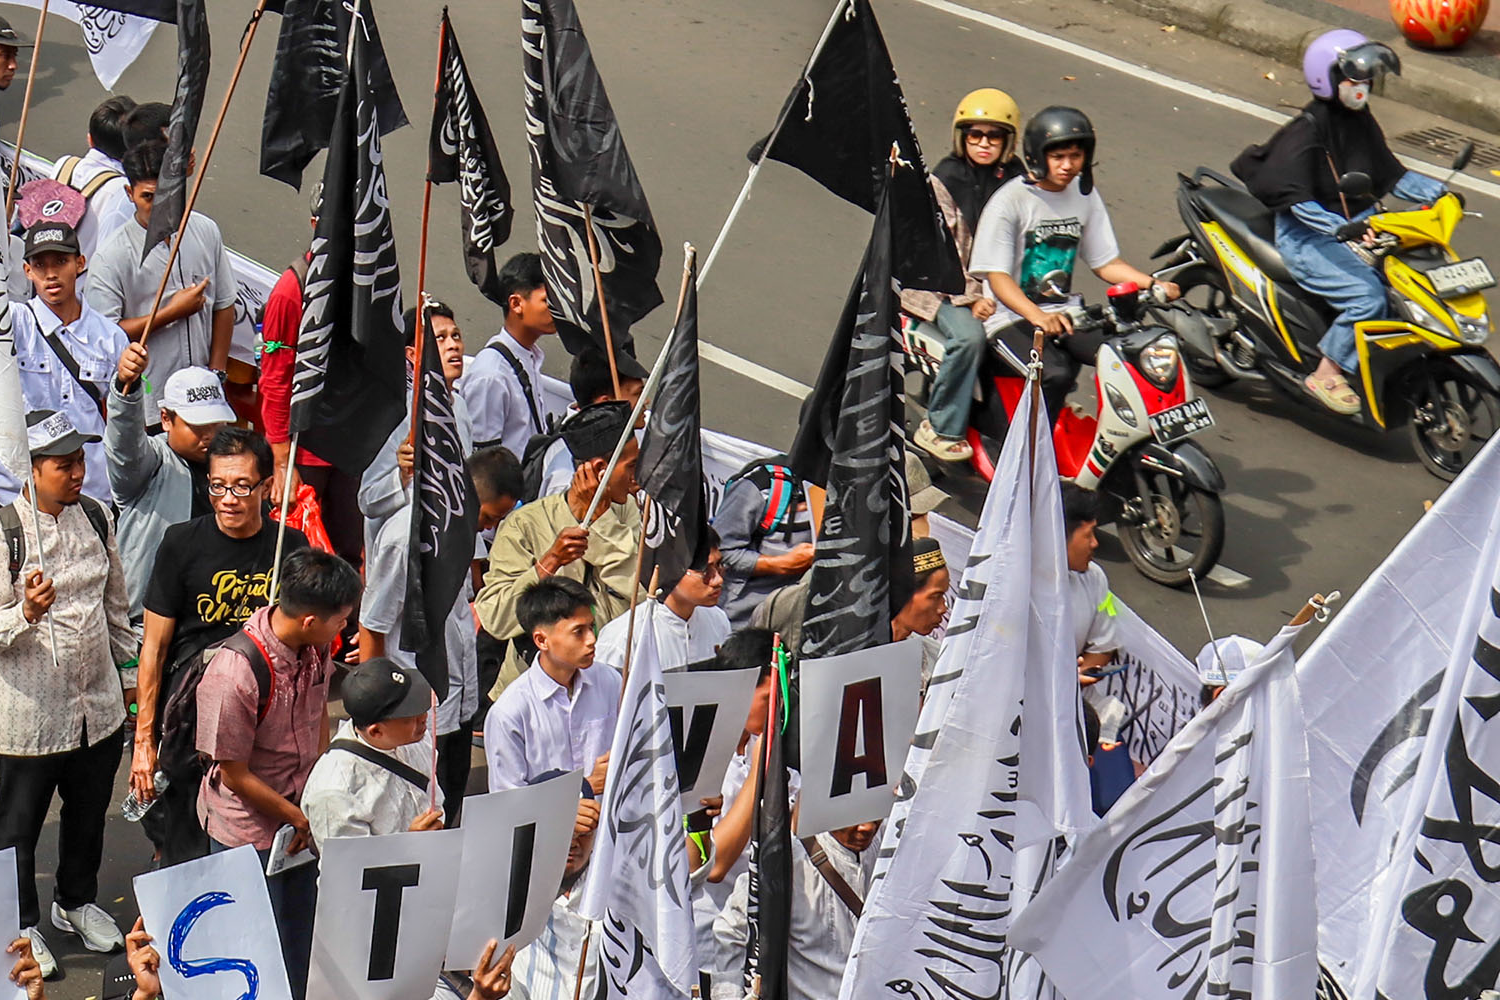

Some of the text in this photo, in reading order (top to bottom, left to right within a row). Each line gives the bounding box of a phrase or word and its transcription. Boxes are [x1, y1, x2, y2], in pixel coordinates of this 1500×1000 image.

[830, 677, 887, 798] A
[362, 864, 420, 981] T
[504, 822, 536, 939] I
